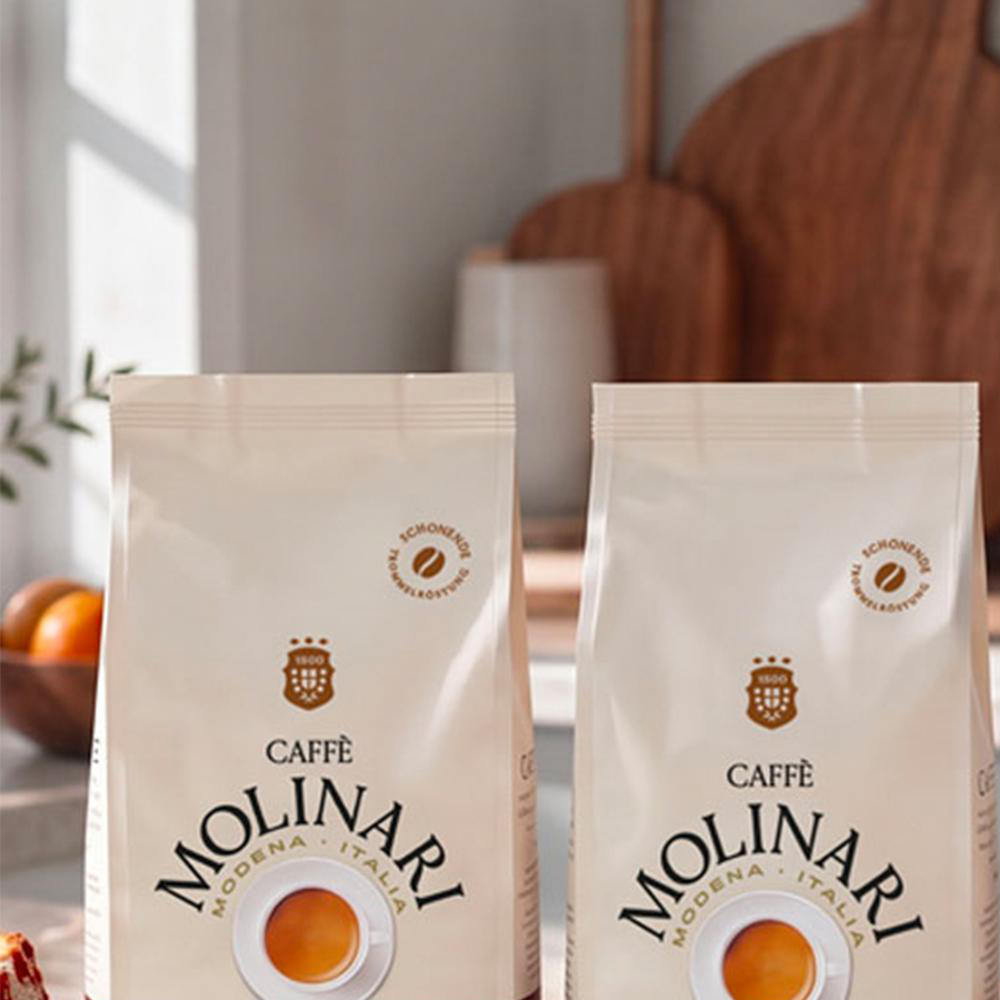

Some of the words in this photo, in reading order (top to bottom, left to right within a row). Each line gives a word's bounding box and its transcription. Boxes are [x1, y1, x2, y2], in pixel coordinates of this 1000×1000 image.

[399, 522, 471, 559] SCHONENDE
[862, 538, 932, 574] SCHONENDE
[266, 735, 353, 764] CAFFÈ
[726, 758, 814, 788] CAFFÈ
[154, 776, 464, 912] MOLINARI
[618, 802, 924, 944] MOLINARI
[211, 835, 306, 918] MODENA
[340, 841, 407, 915] ITALIA
[672, 863, 764, 948] MODENA
[797, 869, 865, 948] ITALIA
